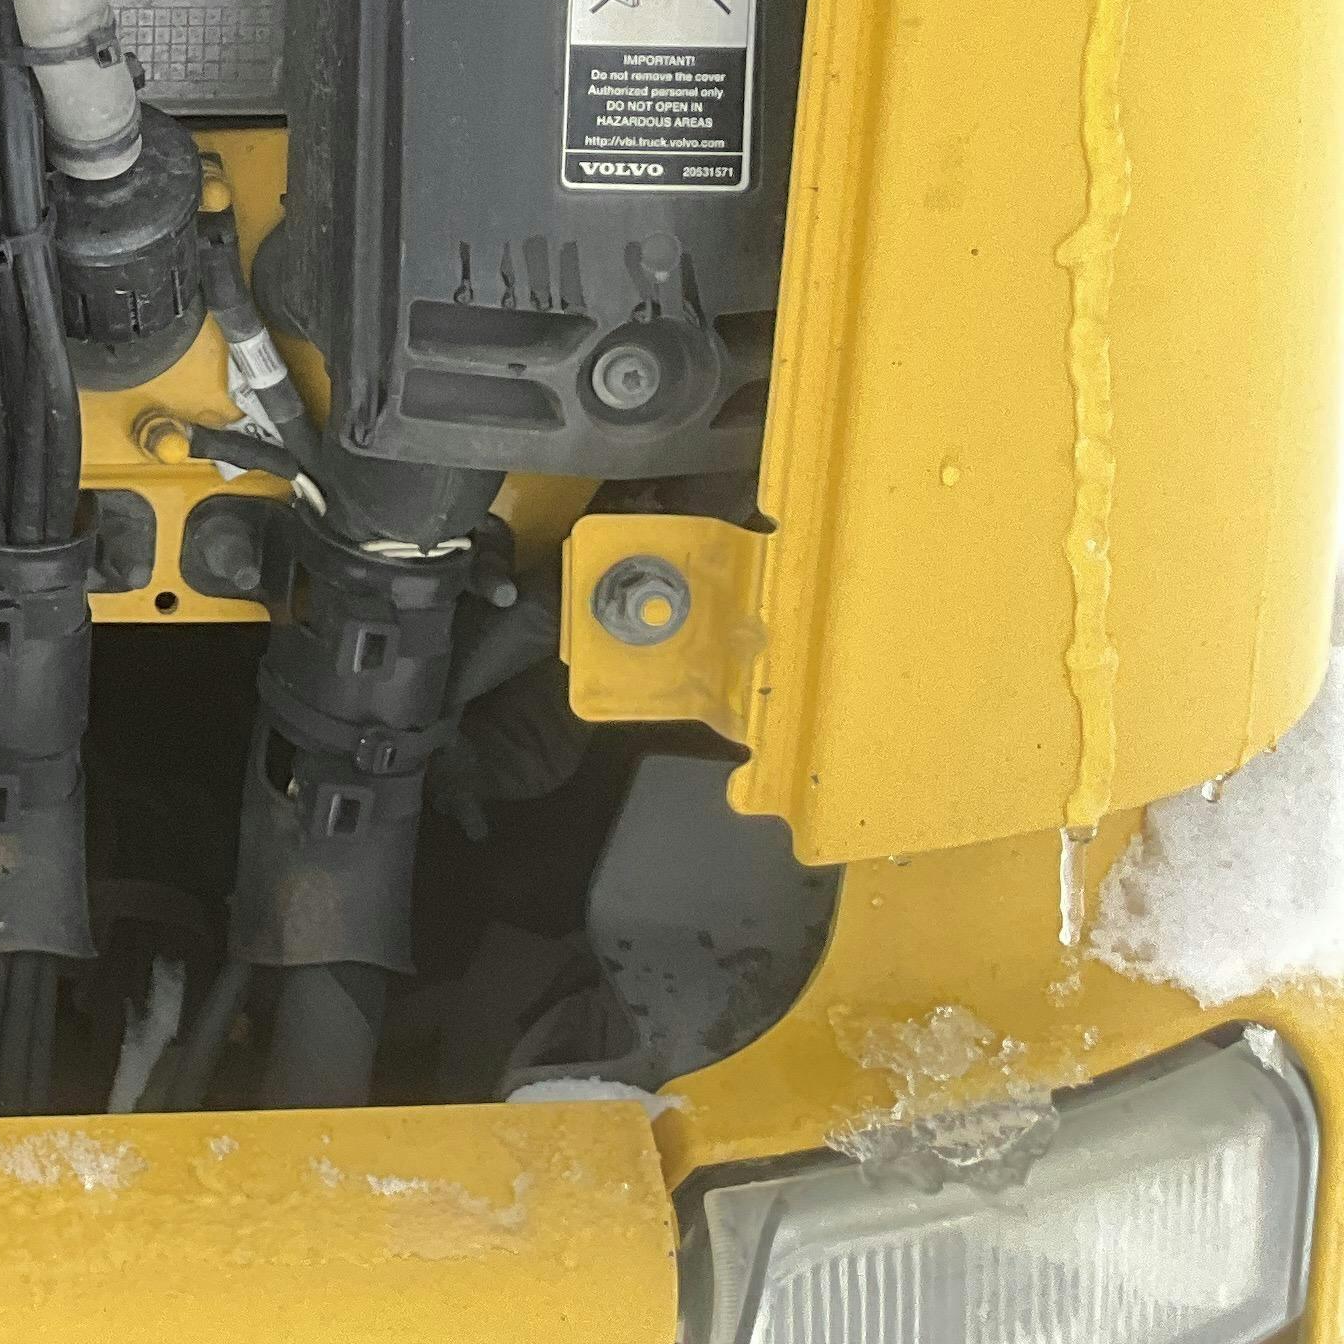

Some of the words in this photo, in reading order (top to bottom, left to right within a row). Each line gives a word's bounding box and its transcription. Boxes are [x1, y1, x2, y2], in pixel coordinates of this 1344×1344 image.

[623, 54, 696, 67] IMPORTANT!
[591, 69, 607, 81] Do
[609, 69, 628, 81] not
[631, 71, 672, 82] remove
[675, 70, 693, 82] the
[694, 72, 726, 83] cover
[588, 84, 649, 97] Authorized
[700, 86, 724, 100] only
[606, 100, 625, 112] DO
[627, 100, 653, 112] NOT
[655, 101, 688, 113] OPEN
[691, 101, 703, 113] IN
[596, 115, 672, 127] HAZARDOUS
[674, 117, 713, 128] AREAS
[578, 161, 664, 176] VOLVO
